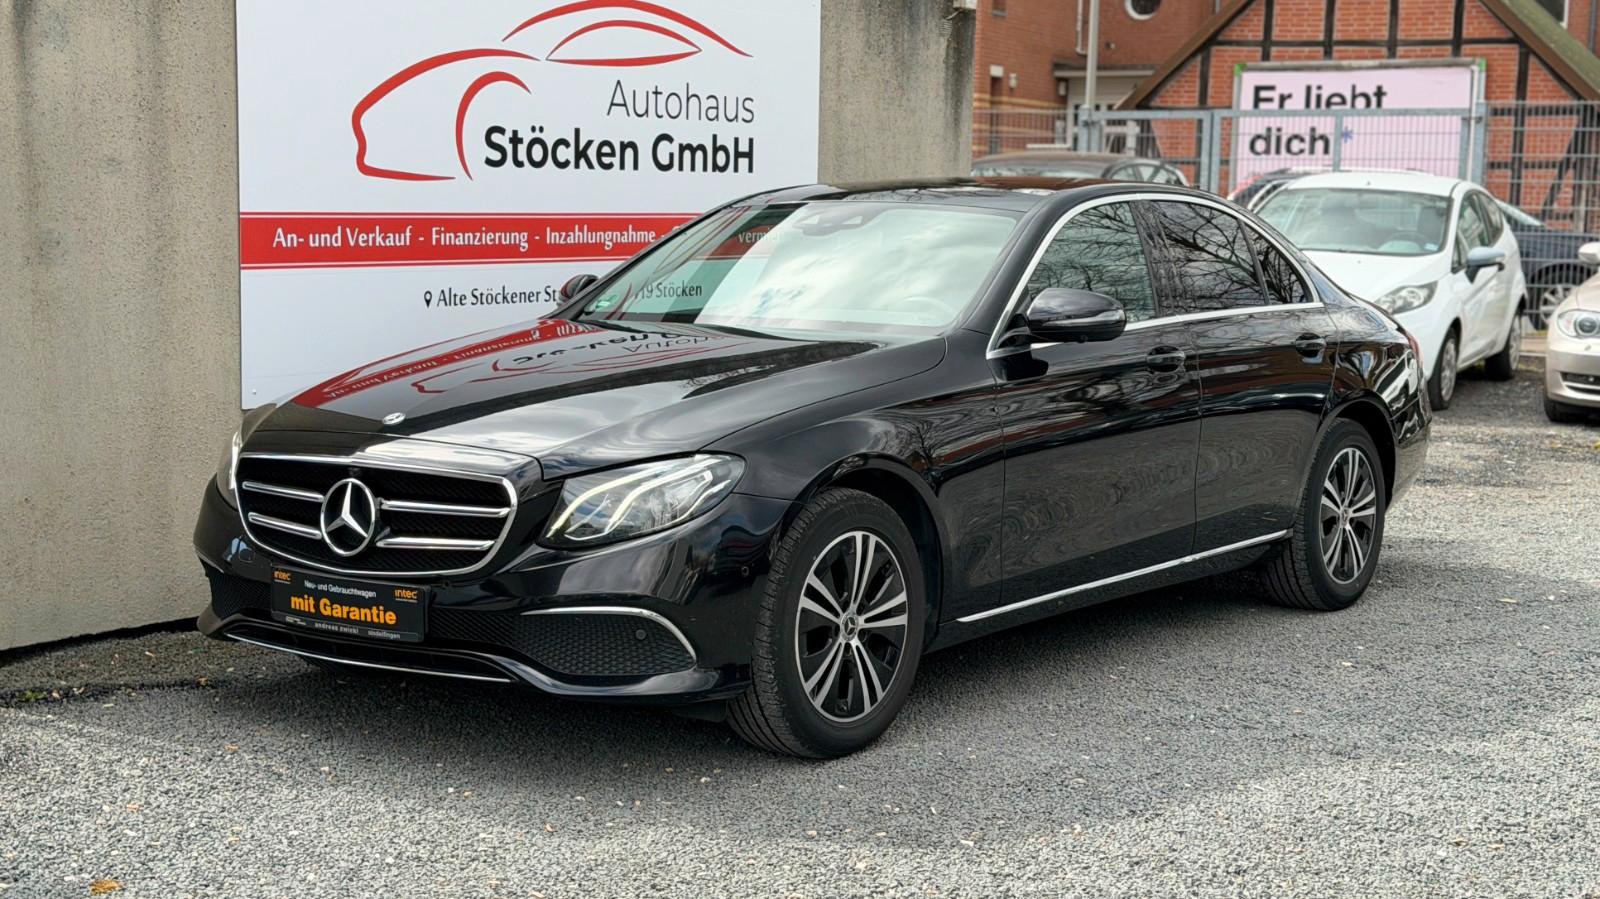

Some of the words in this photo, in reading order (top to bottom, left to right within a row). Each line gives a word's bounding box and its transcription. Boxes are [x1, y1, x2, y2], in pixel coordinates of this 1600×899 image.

[606, 79, 755, 124] Autohaus
[1304, 84, 1387, 110] liebt
[484, 125, 640, 171] Stöcken
[651, 132, 755, 174] GmbH
[1249, 126, 1330, 156] dich
[272, 227, 305, 248] An-
[308, 225, 342, 247] und
[345, 225, 413, 247] Verkauf
[431, 226, 529, 252] Finanzierung
[546, 224, 656, 250] Inzahlungnahme
[436, 287, 468, 307] Alte
[471, 285, 542, 306] Stöckener
[656, 280, 703, 298] Stöcken
[317, 583, 328, 592] und
[328, 584, 377, 599] Gebrauchtwagen
[394, 588, 418, 600] intec
[290, 594, 316, 613] mit
[319, 597, 398, 626] Garantie
